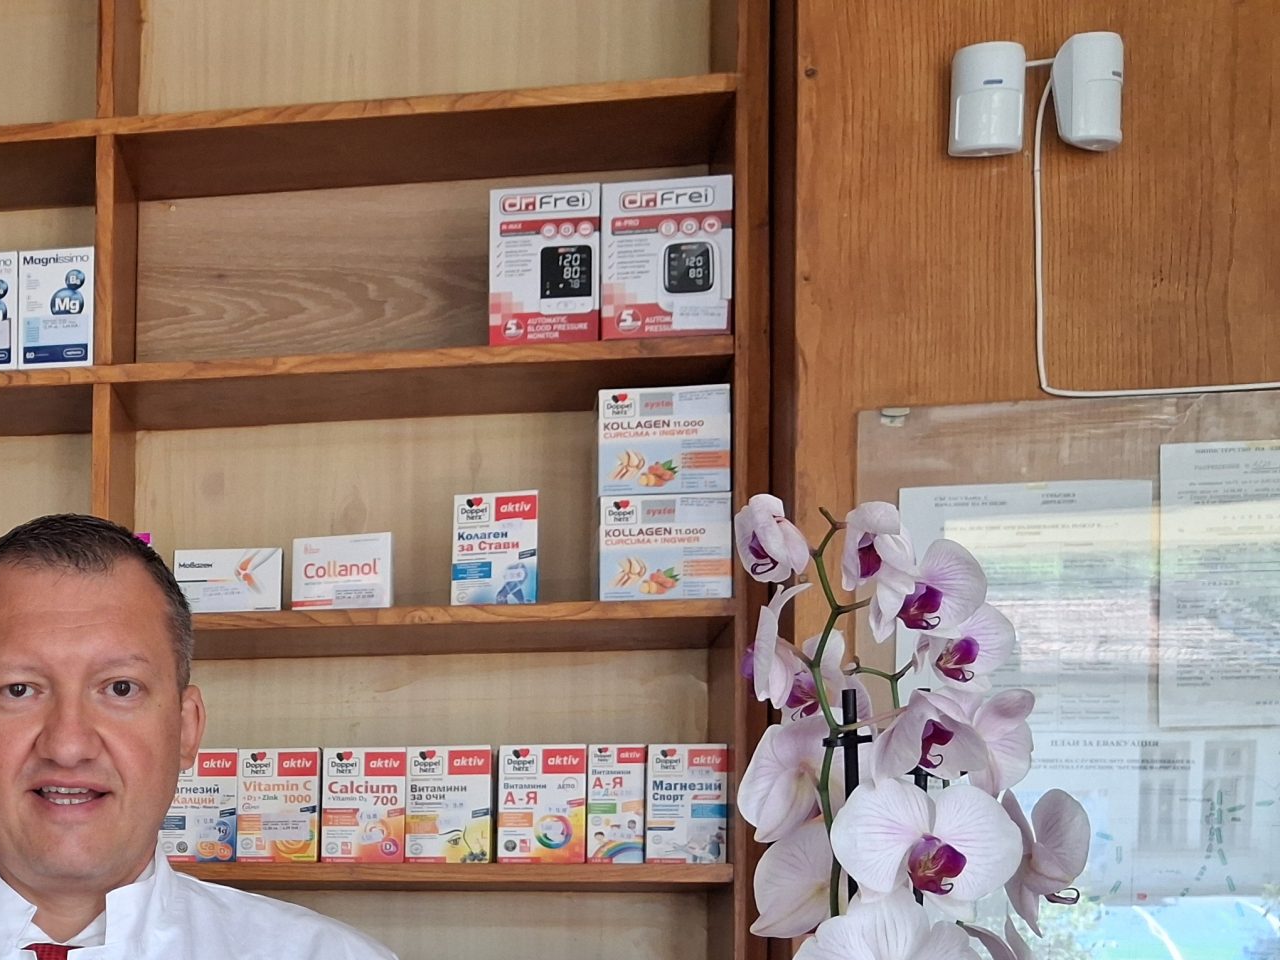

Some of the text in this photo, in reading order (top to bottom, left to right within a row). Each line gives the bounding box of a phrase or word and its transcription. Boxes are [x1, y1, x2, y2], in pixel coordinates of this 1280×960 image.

[22, 253, 89, 266] Magnissimo
[558, 254, 580, 266] 120
[563, 267, 580, 279] 80
[55, 298, 80, 313] Mg
[603, 420, 670, 431] KOLLAGEN
[500, 502, 531, 512] aktiv
[458, 531, 508, 541] Колаген
[605, 527, 672, 538] KOLLAGEN
[457, 541, 520, 552] за Стави
[304, 558, 378, 579] Collanol
[203, 760, 232, 768] aktiv
[283, 759, 312, 768] aktiv
[370, 759, 400, 768] aktiv
[414, 760, 440, 768] Doppel
[453, 757, 484, 766] aktiv
[507, 758, 534, 766] Doppel
[547, 756, 579, 765] aktiv
[693, 755, 722, 764] aktiv
[246, 762, 270, 770] Doppel
[176, 784, 219, 794] агнезий
[243, 780, 312, 791] Vitamin C
[328, 781, 397, 794] Calcium
[410, 784, 467, 793] Витамини
[652, 779, 722, 791] Магнезий
[283, 795, 311, 804] 1000
[373, 796, 397, 805] 700
[652, 793, 684, 803] Спорт
